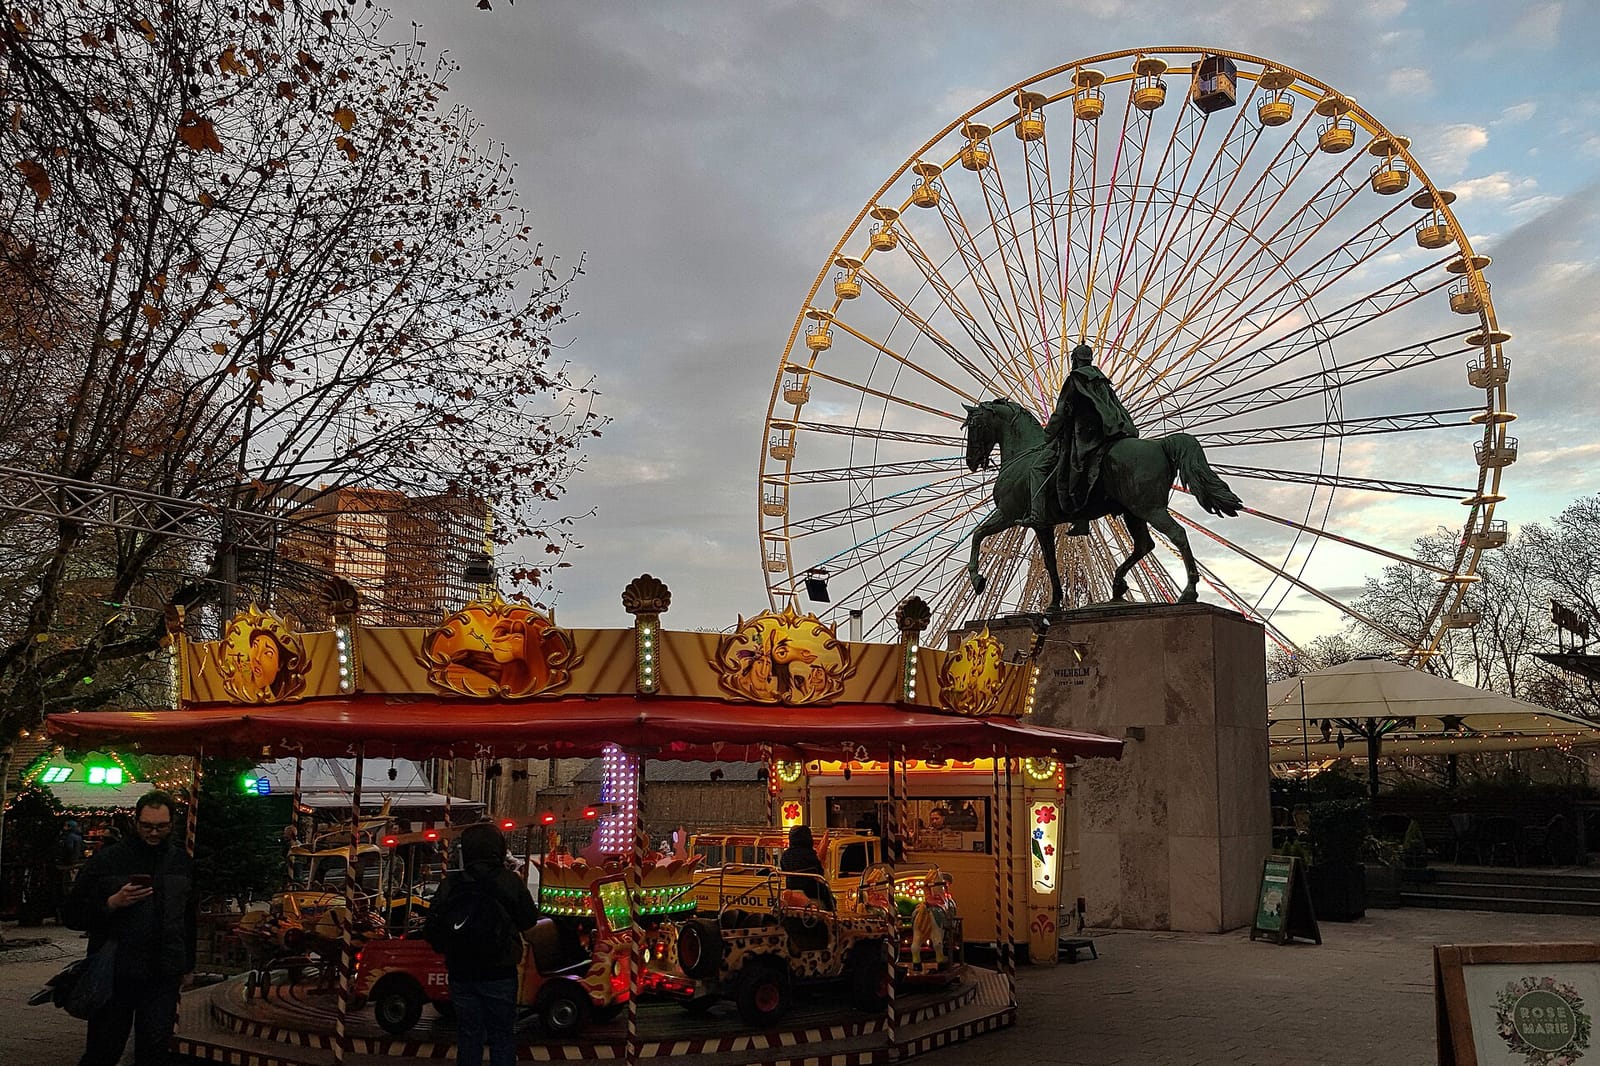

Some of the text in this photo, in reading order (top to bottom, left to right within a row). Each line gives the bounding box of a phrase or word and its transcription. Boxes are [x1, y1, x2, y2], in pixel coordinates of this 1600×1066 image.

[1054, 667, 1090, 677] WILHELM
[720, 895, 763, 907] SCHOOL
[1519, 1006, 1567, 1019] ROSE
[1522, 1022, 1569, 1034] MARIE
